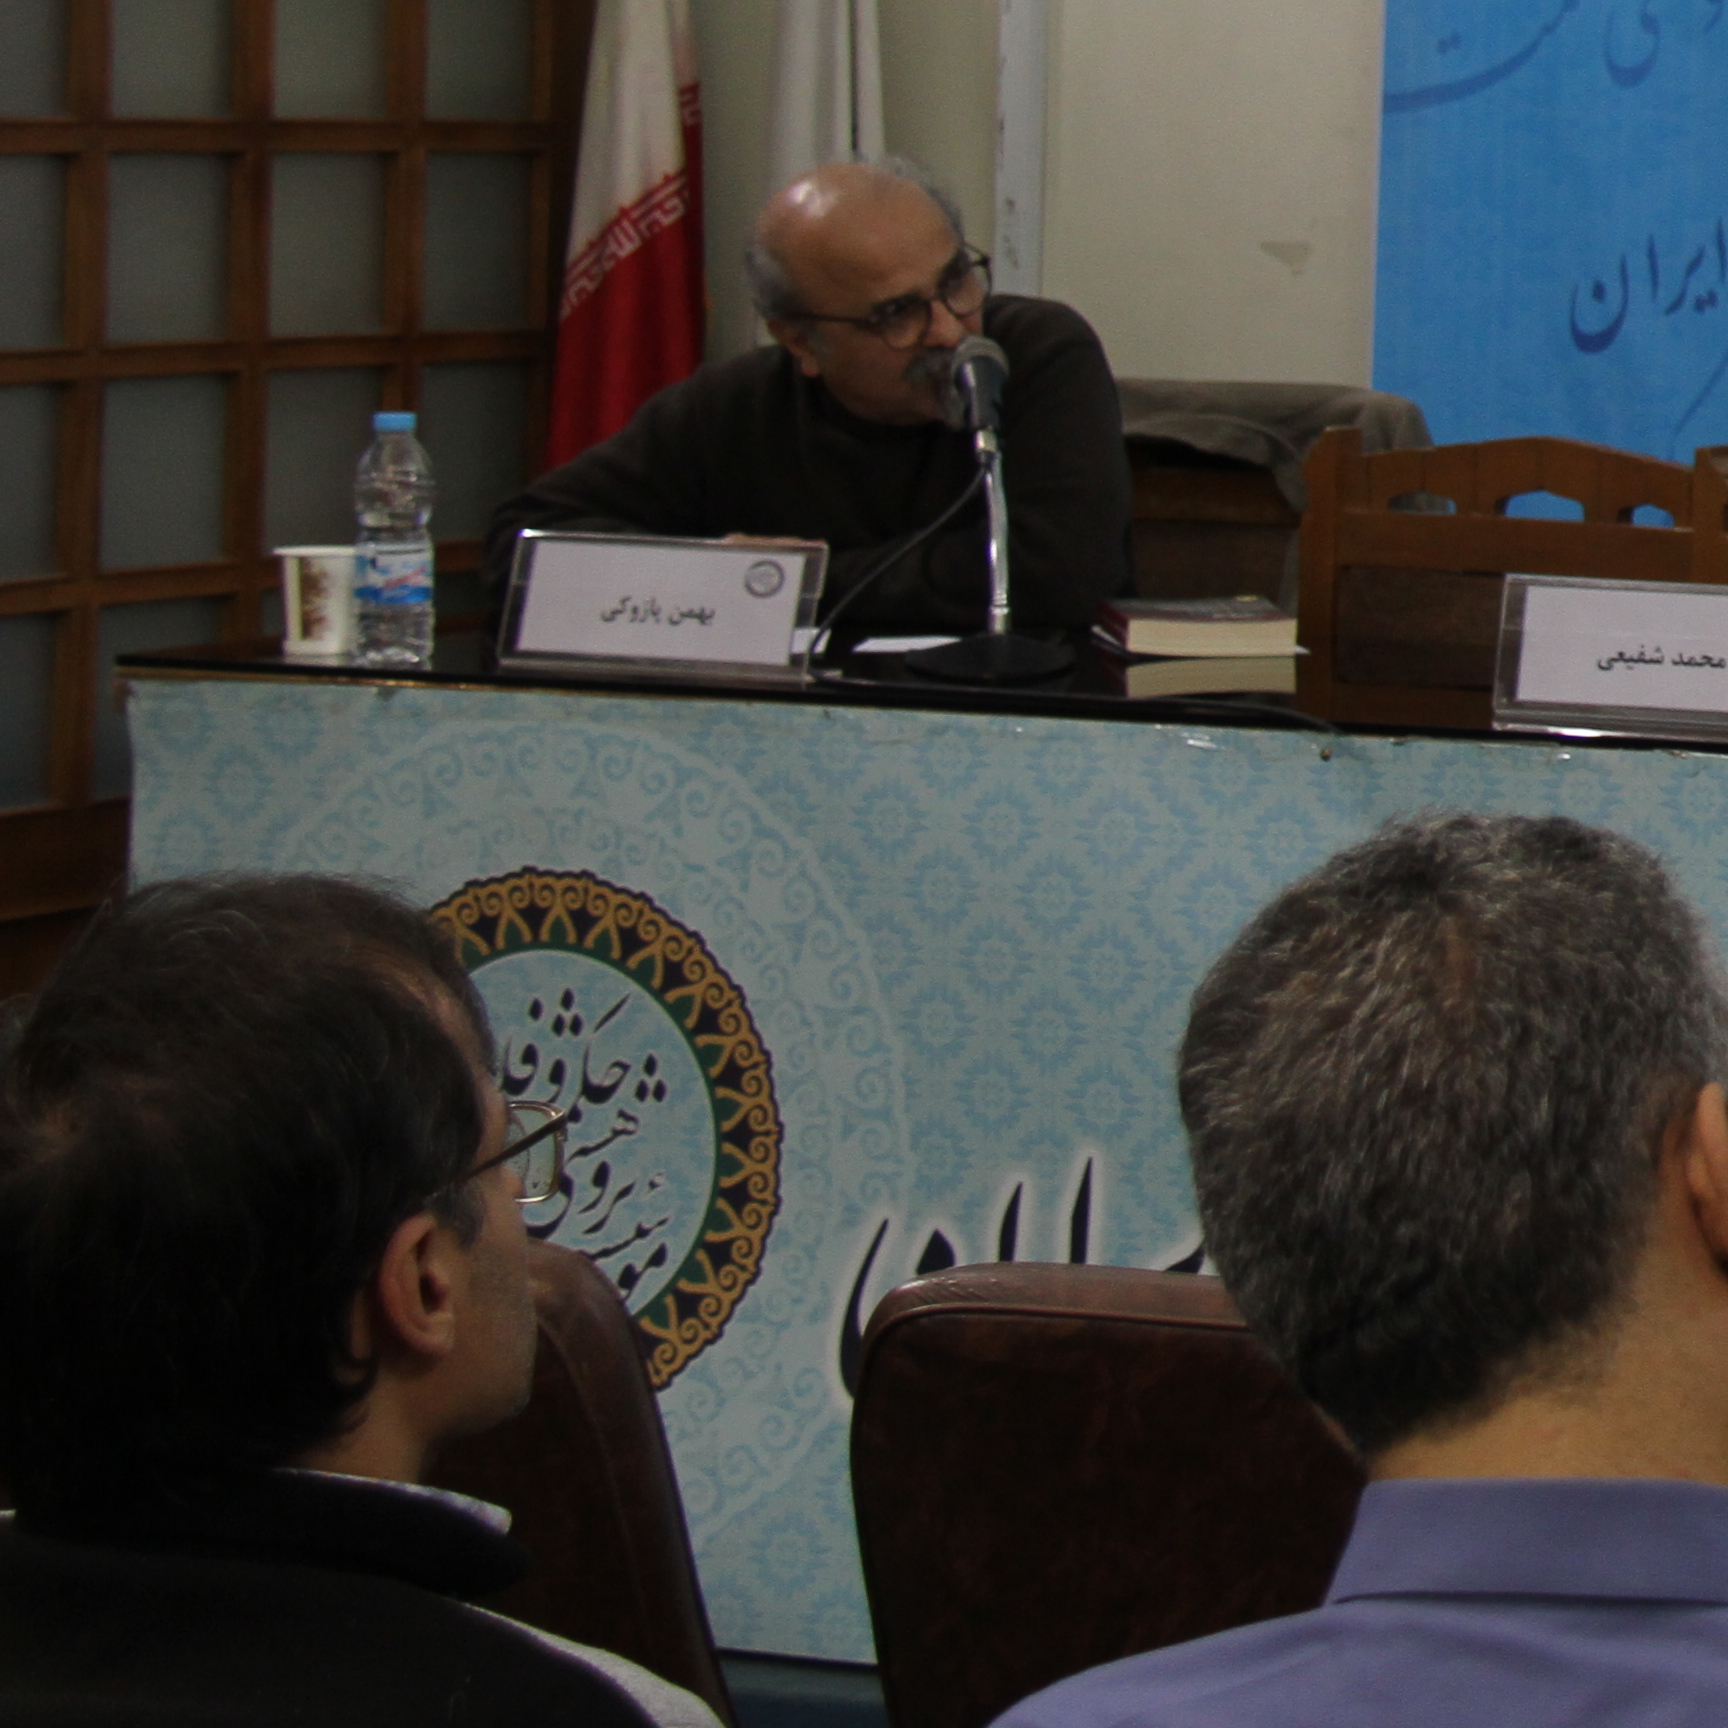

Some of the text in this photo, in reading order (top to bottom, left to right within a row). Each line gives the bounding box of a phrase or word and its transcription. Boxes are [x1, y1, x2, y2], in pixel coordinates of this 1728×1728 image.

[1569, 215, 1728, 354] ایران
[667, 604, 716, 627] بهمن
[1596, 643, 1728, 671] محمد شفیعی
